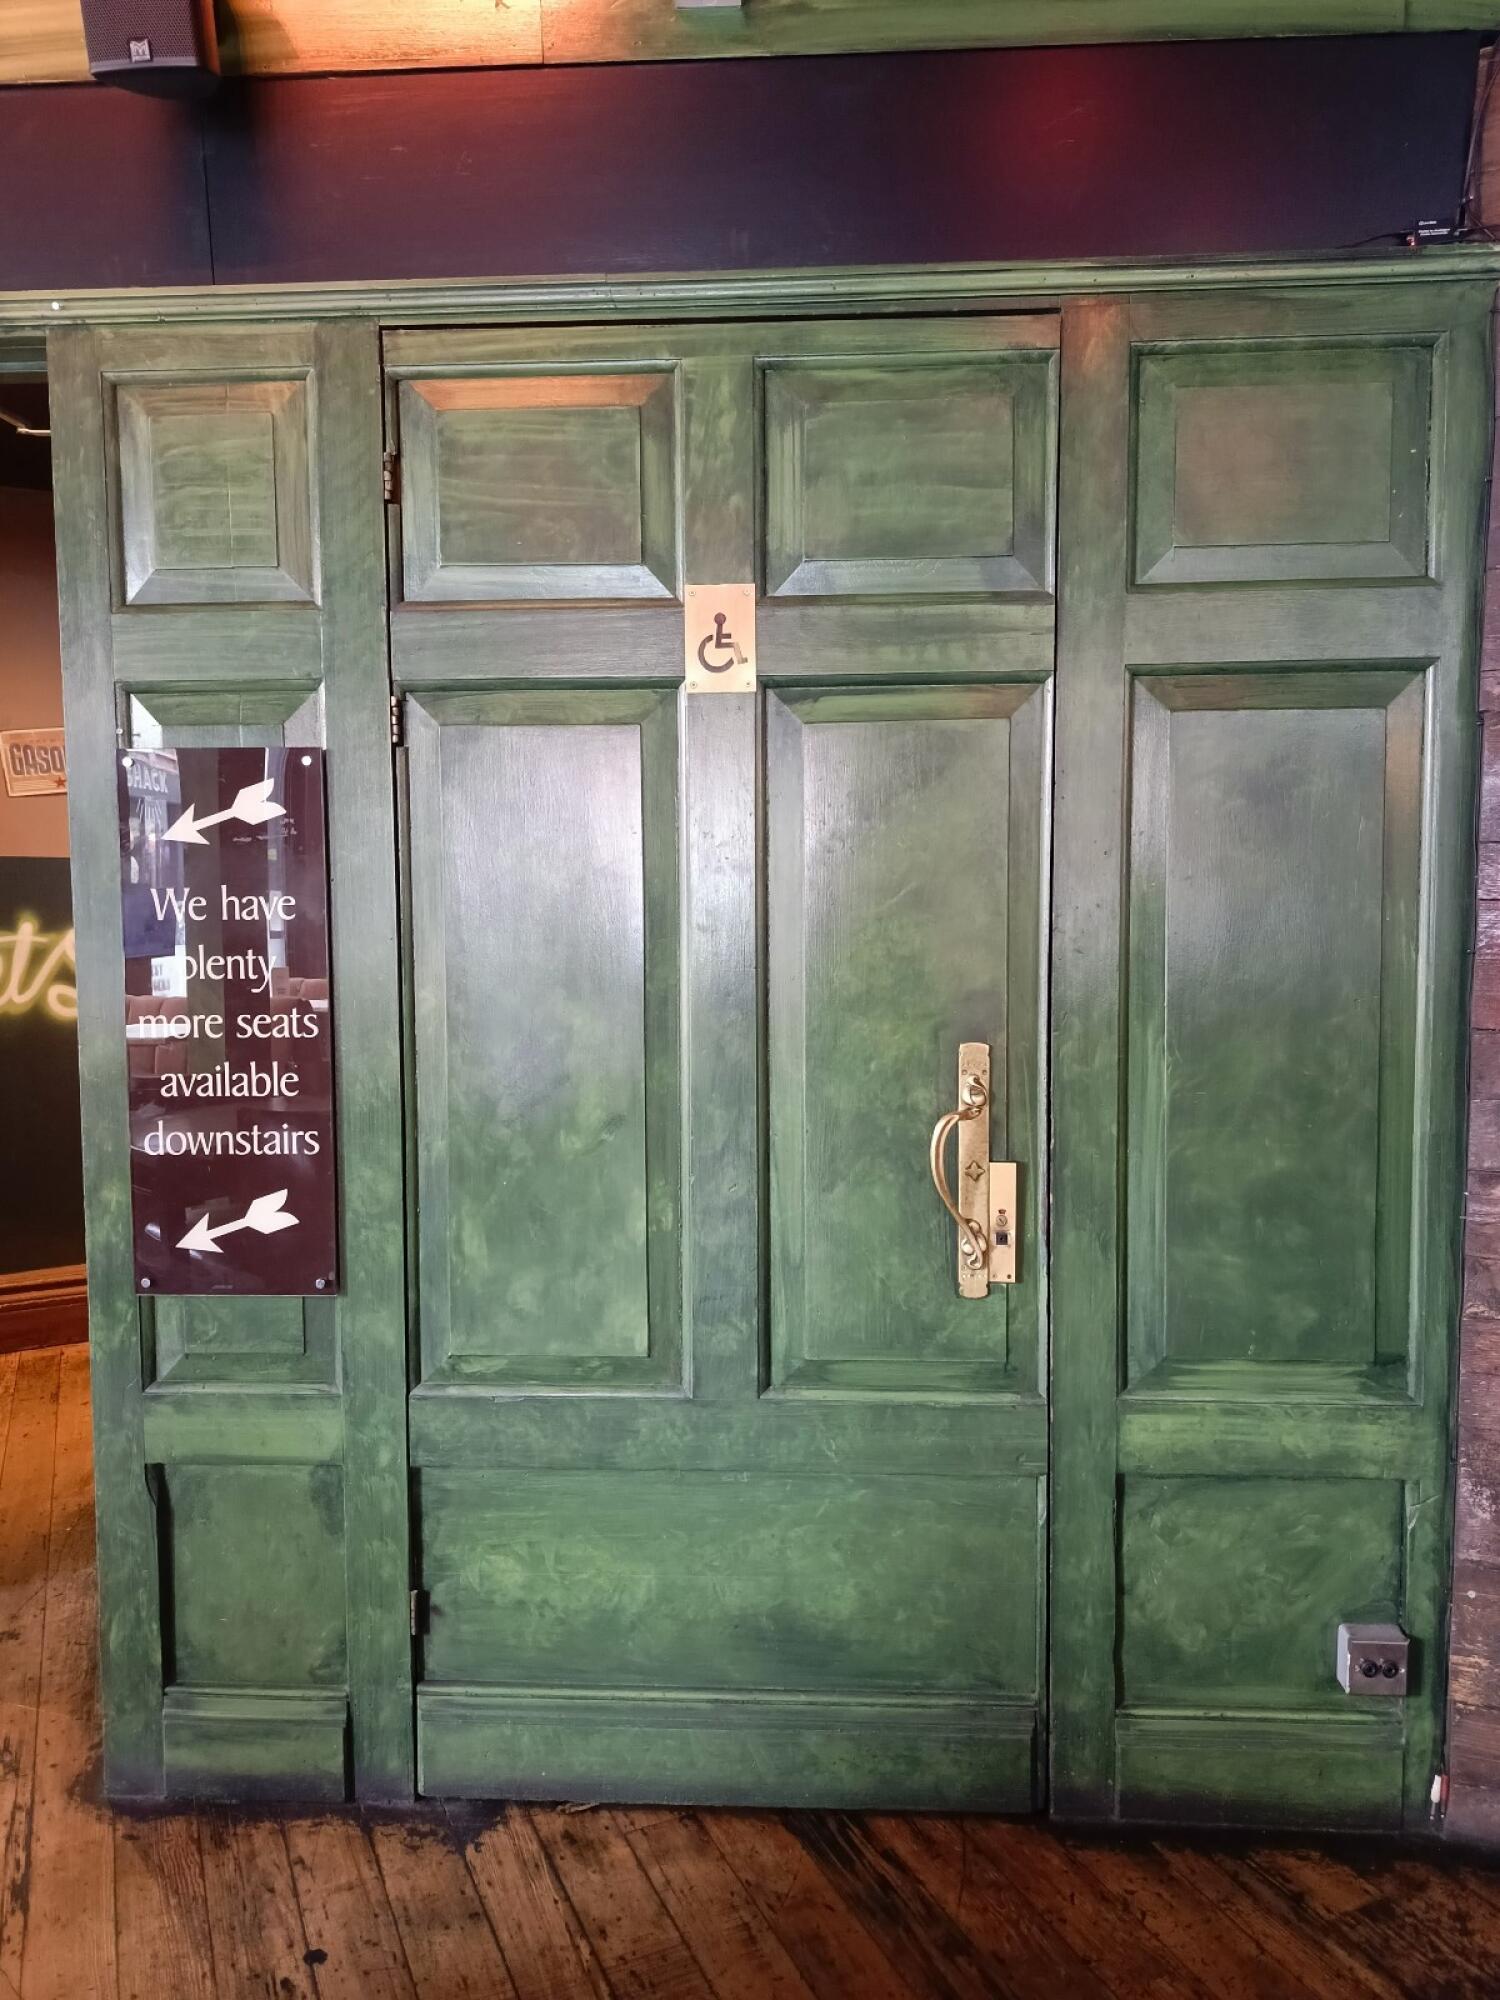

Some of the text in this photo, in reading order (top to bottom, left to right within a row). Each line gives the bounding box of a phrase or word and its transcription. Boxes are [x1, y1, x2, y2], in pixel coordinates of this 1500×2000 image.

[150, 884, 296, 921] We have
[138, 1007, 319, 1039] more seats
[160, 1061, 299, 1097] available
[143, 1119, 320, 1156] downstairs
